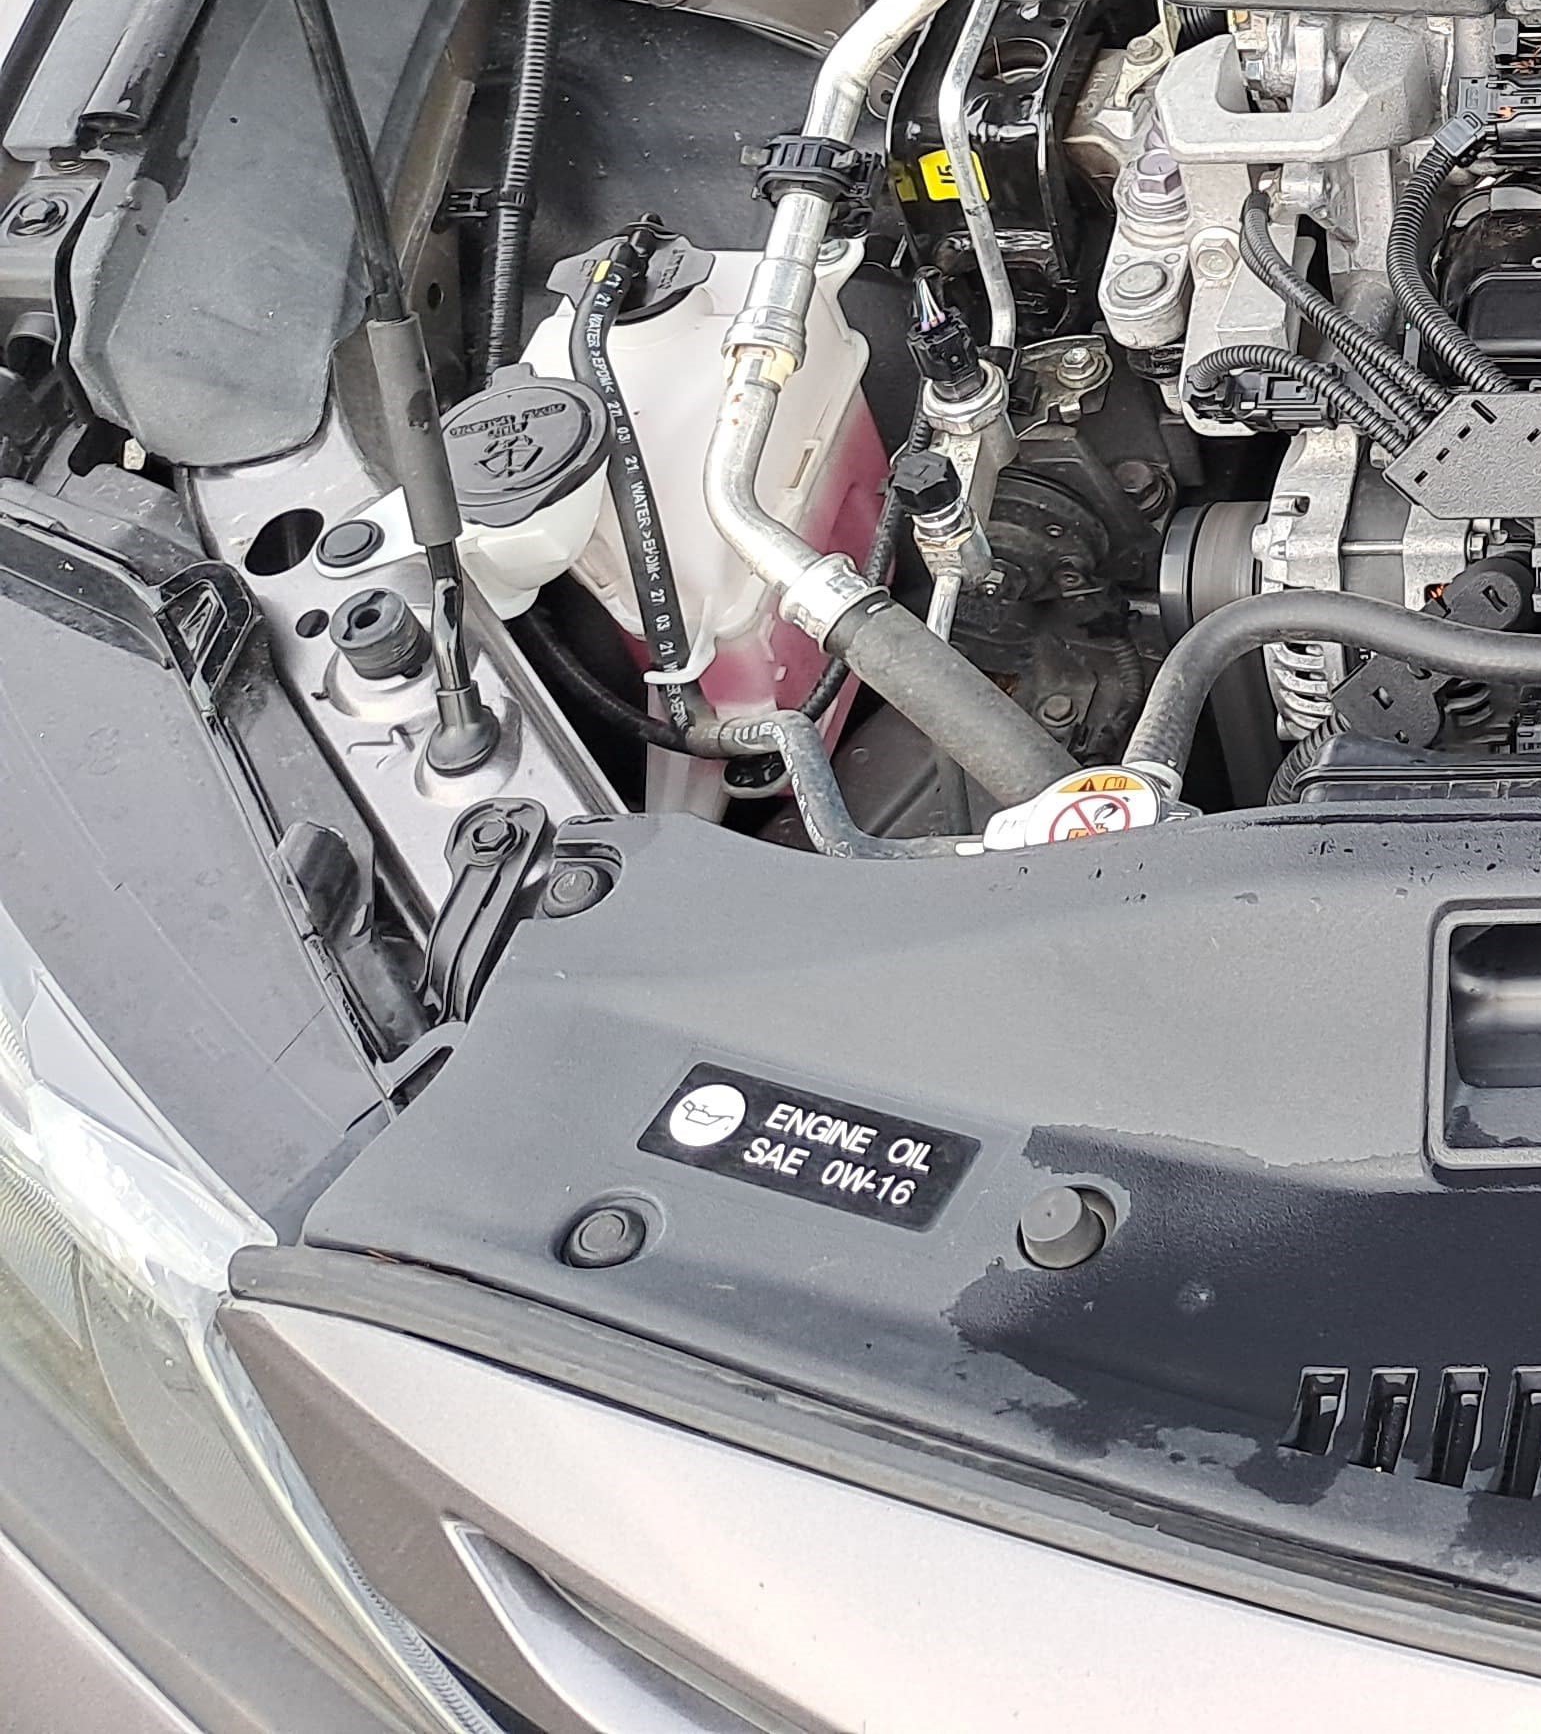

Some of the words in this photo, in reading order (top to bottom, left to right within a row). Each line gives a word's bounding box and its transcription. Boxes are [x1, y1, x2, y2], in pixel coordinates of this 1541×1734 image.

[585, 313, 605, 348] WATER
[630, 480, 652, 529] WATER
[742, 1135, 811, 1176] SAE
[820, 1159, 917, 1208] 0W-16
[764, 1102, 879, 1155] ENGINE
[885, 1137, 933, 1175] OIL
